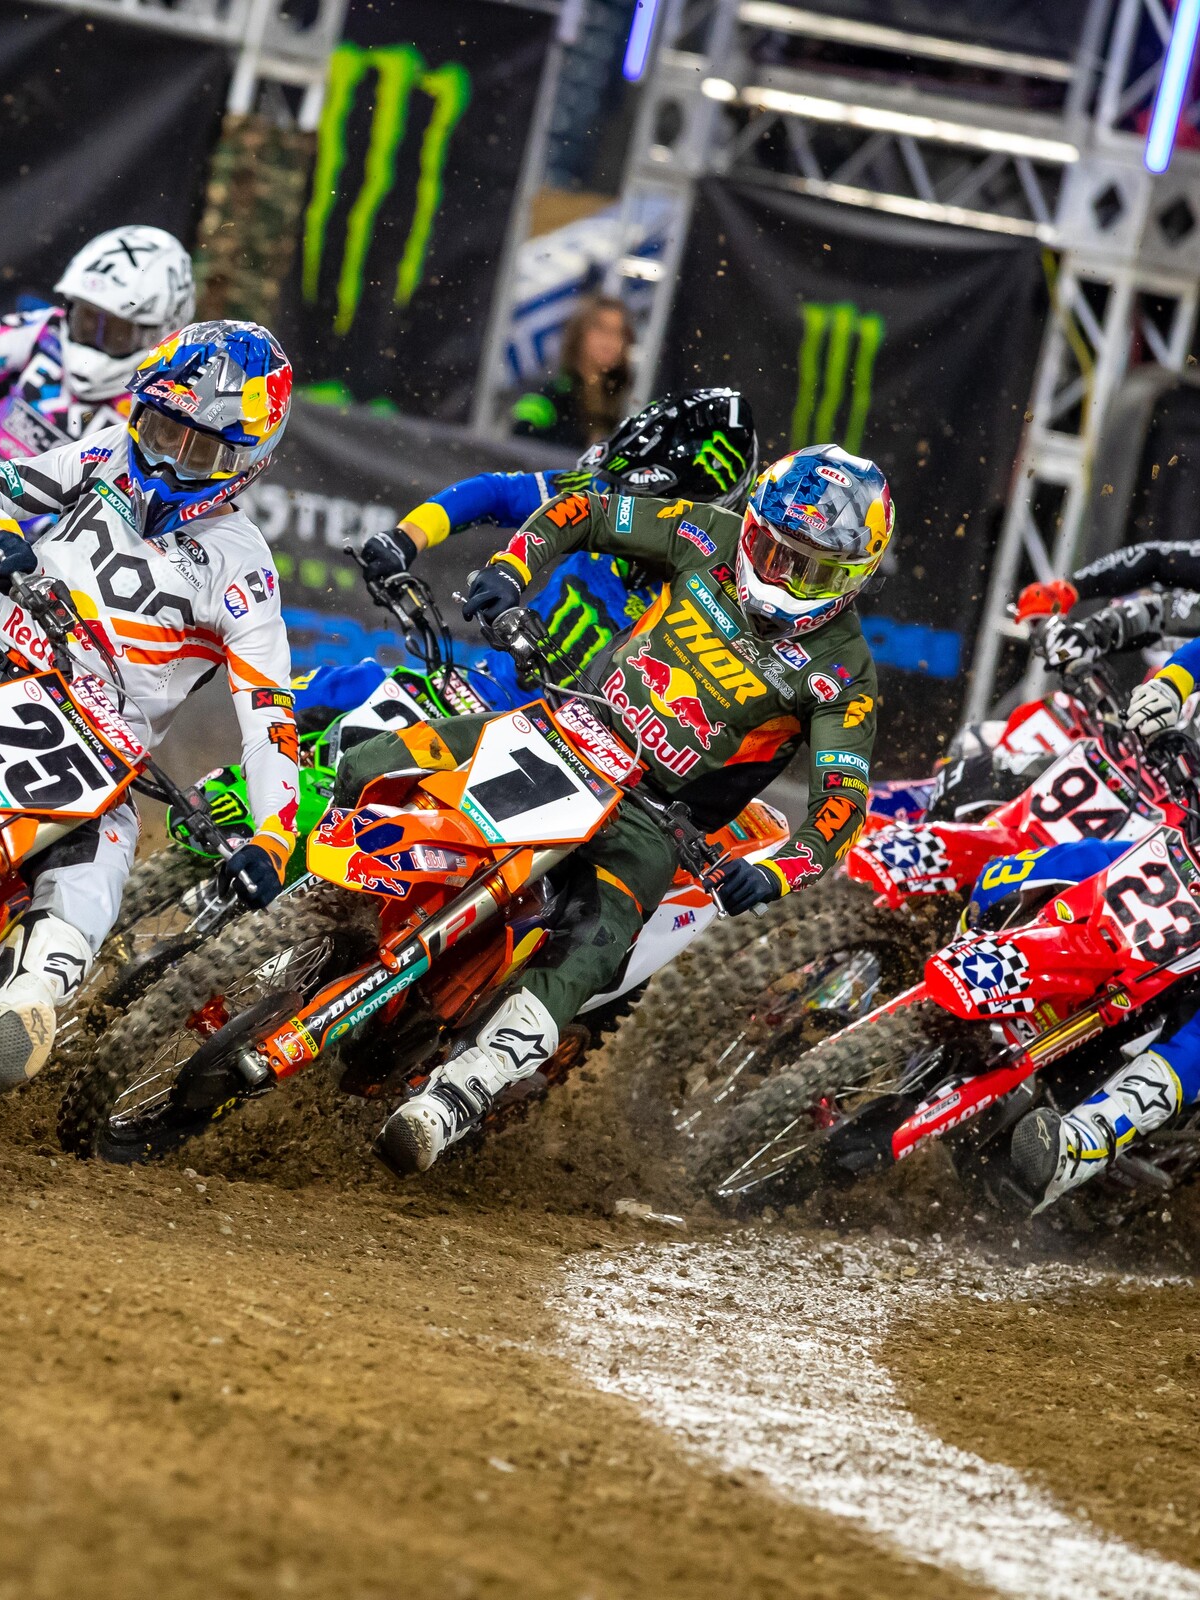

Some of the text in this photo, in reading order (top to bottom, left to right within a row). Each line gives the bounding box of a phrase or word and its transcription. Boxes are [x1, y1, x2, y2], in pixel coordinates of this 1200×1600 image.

[144, 384, 199, 414] RedBull
[628, 467, 670, 485] Airoh
[820, 467, 847, 485] BELL
[786, 503, 827, 531] RedBull
[177, 535, 205, 563] Airoh
[225, 588, 247, 617] 100%
[696, 587, 734, 634] MOTOREX
[663, 633, 731, 709] THE FIRST THE FOREVER
[665, 599, 768, 706] THOR
[813, 677, 835, 701] BEL
[68, 709, 104, 752] MONSTER
[562, 711, 623, 777] RENTHAL
[573, 703, 633, 768] RENTHAL
[601, 667, 702, 776] RedBull
[554, 738, 590, 778] MONSTER
[467, 747, 580, 823] 1
[1030, 766, 1130, 841] 94
[468, 808, 500, 843] MOTOREX
[671, 909, 697, 933] AMA
[1101, 861, 1200, 964] 23
[326, 946, 416, 1019] DUNLP
[349, 971, 417, 1027] MOTOREX
[932, 959, 975, 1014] HONDA
[291, 1018, 318, 1054] ACERBIS
[898, 1093, 993, 1160] DNLOP
